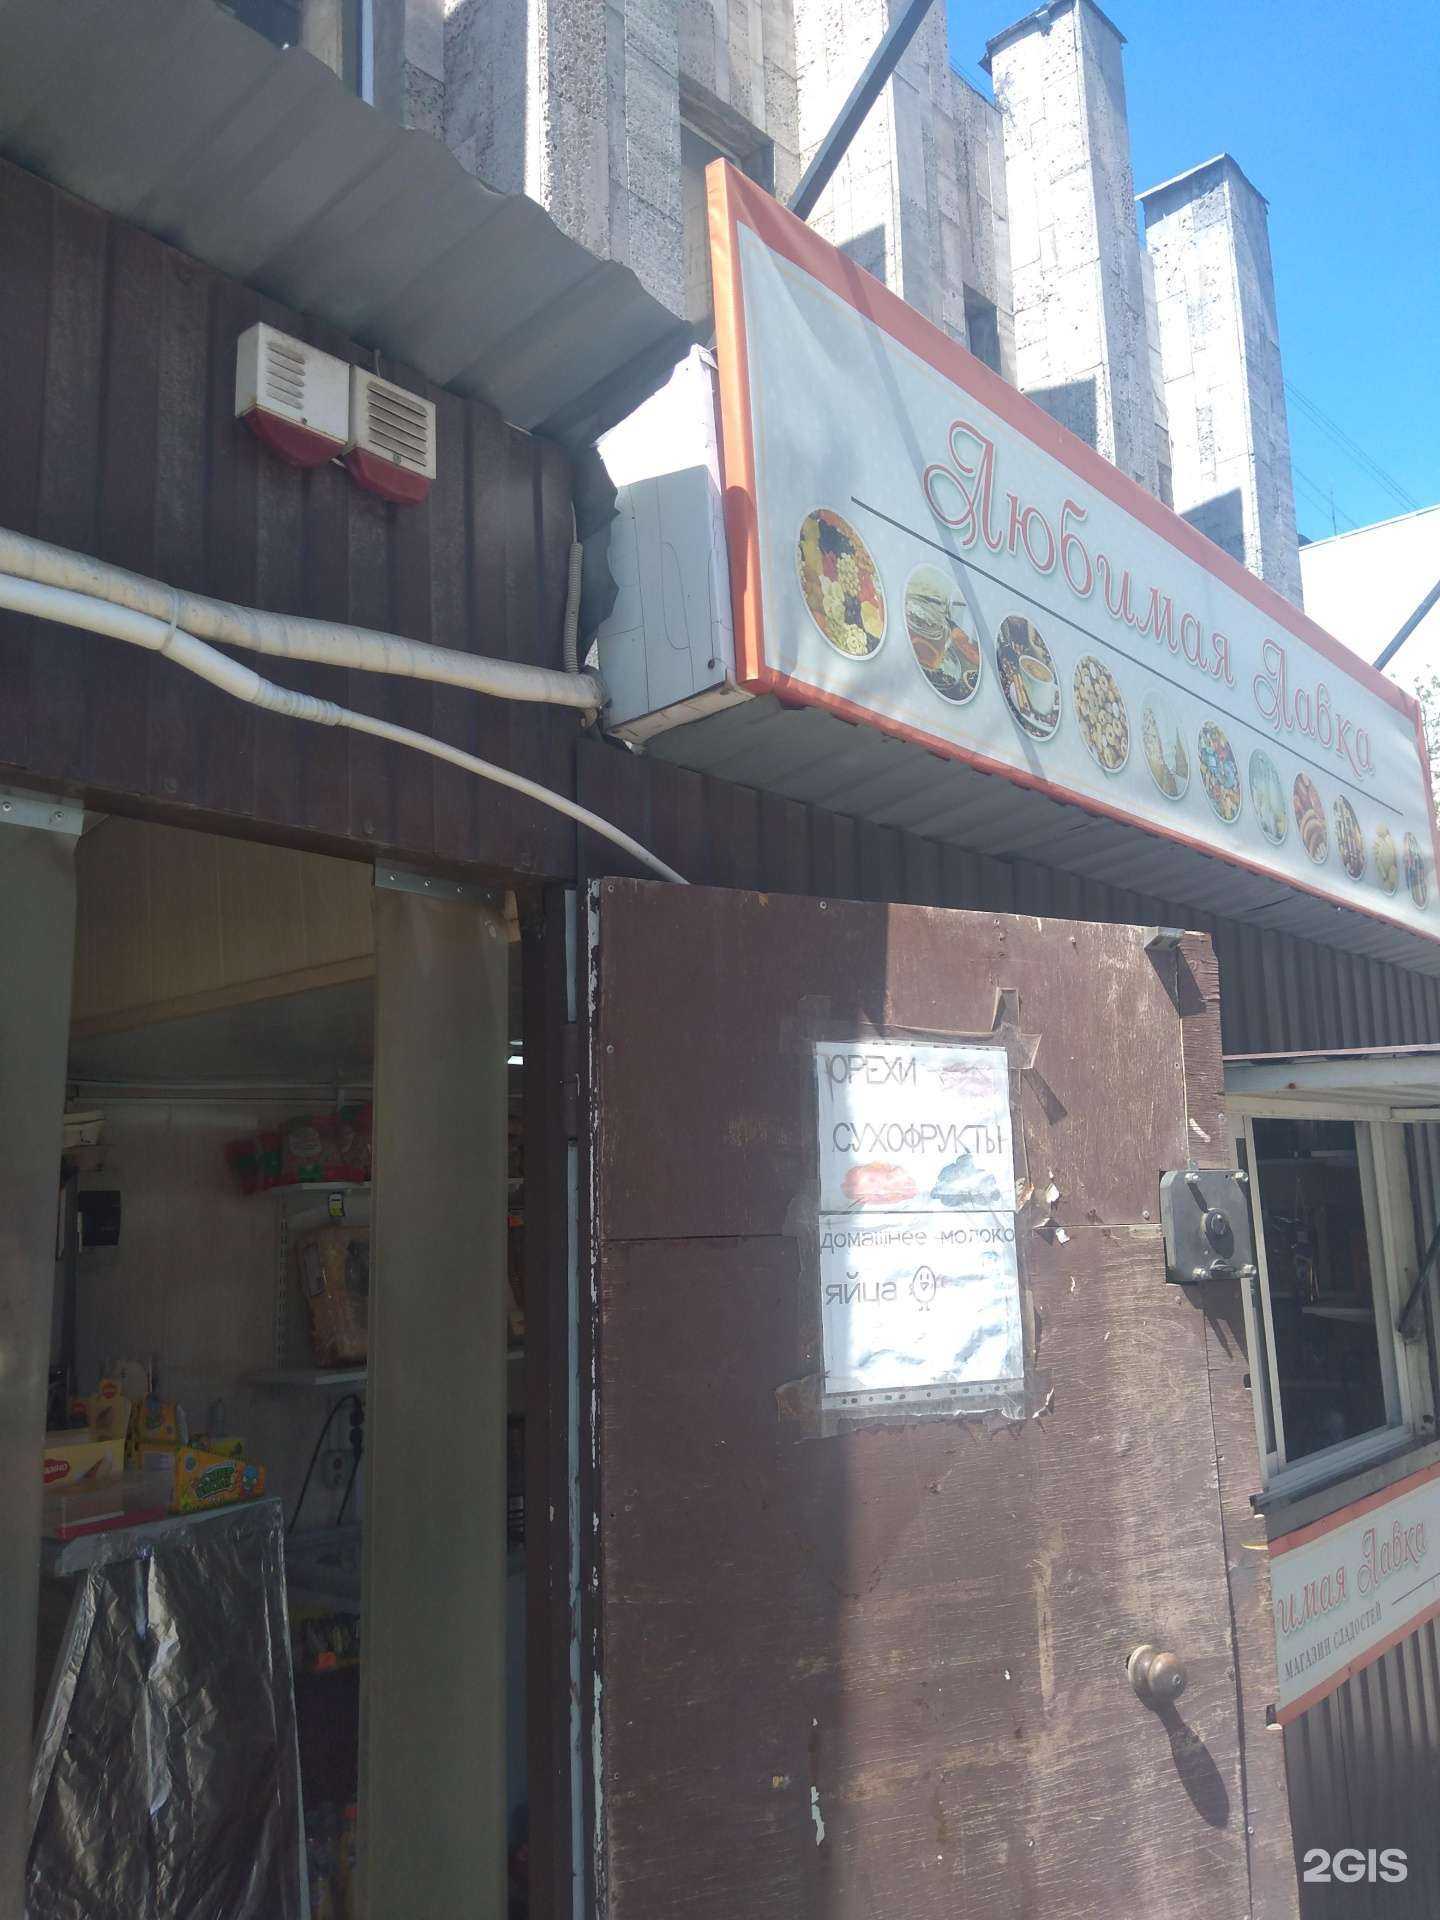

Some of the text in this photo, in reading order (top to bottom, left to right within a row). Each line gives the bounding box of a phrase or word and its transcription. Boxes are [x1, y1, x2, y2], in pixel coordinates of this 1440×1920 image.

[924, 421, 1373, 777] Любимая Лавка
[830, 1054, 916, 1087] ОРЕХИ
[832, 1122, 1003, 1153] СУХОФРУКТЫ
[825, 1272, 897, 1306] яйца
[1357, 1520, 1426, 1594] Лавка
[1284, 1600, 1382, 1680] МАГАЗИН СЛАДОСТЕЙ
